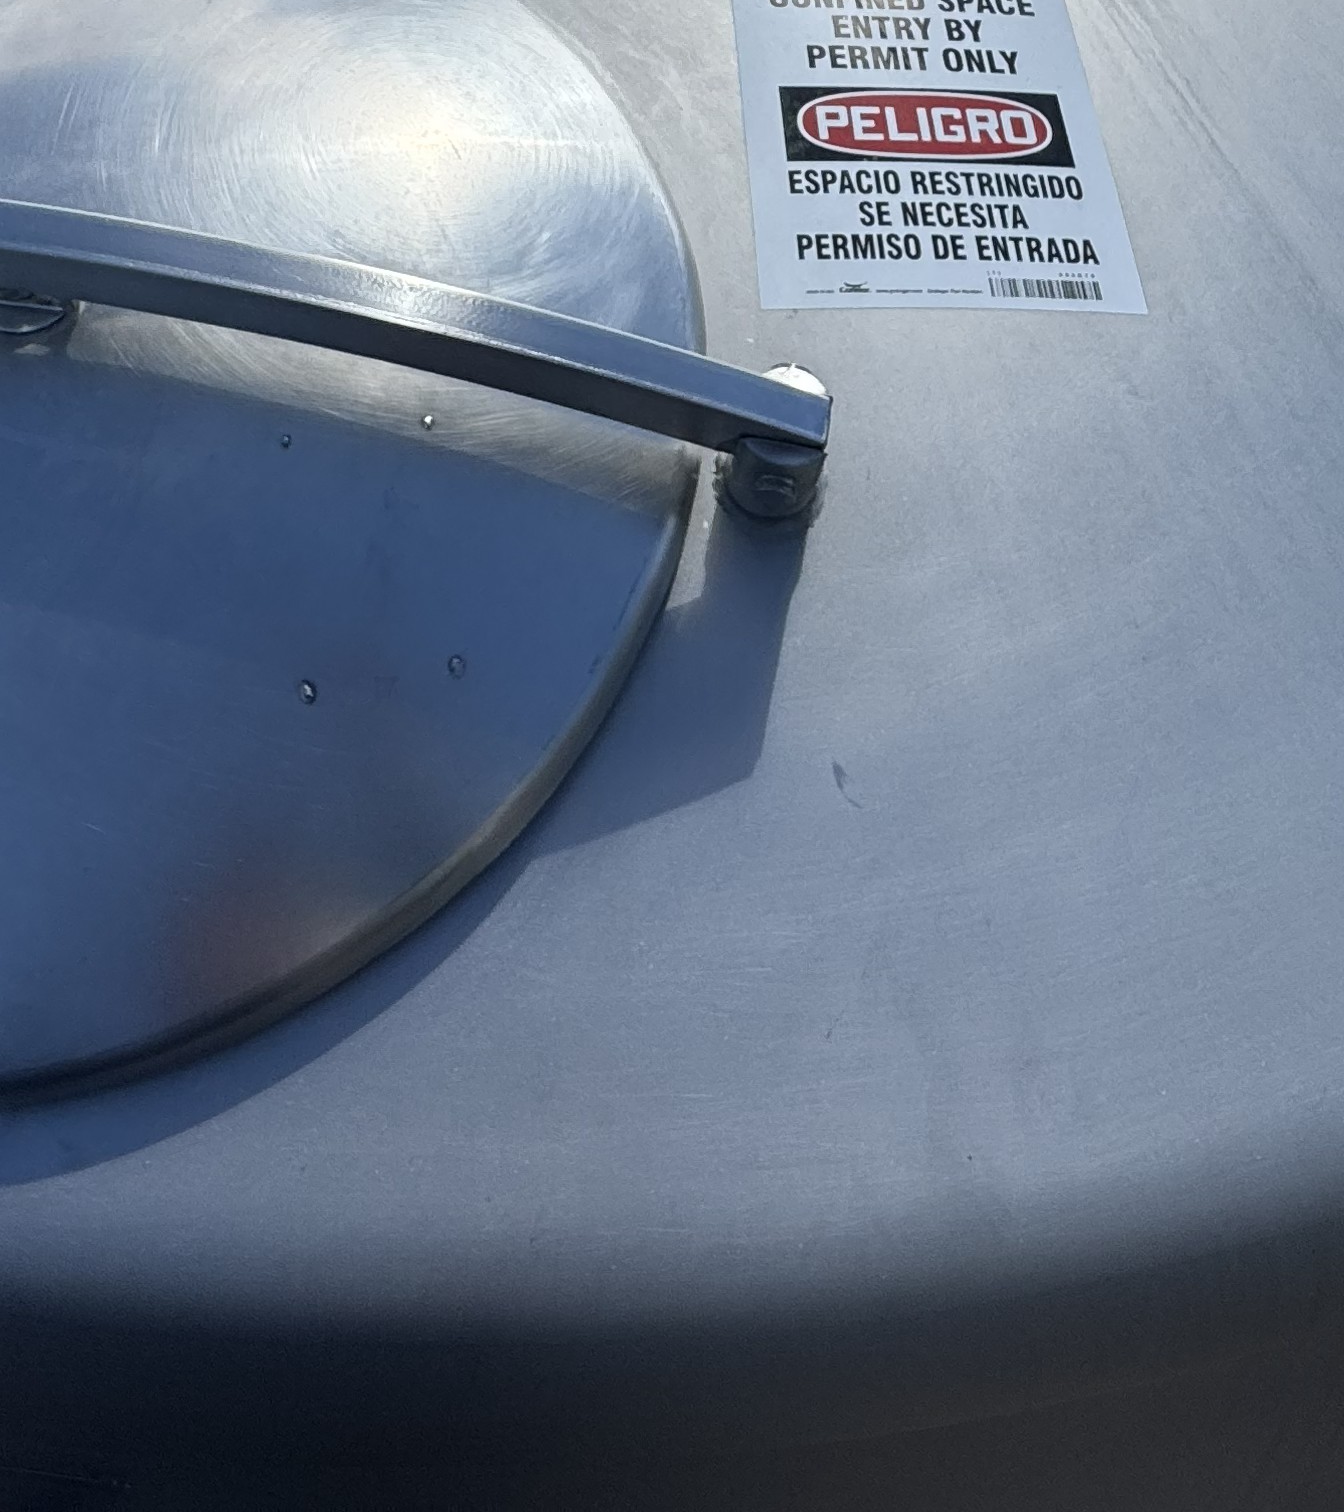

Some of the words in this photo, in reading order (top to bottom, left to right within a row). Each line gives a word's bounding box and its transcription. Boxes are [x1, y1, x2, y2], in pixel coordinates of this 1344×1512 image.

[832, 14, 931, 41] ENTRY
[943, 18, 982, 43] BY
[806, 44, 929, 71] PERMIT
[942, 47, 1018, 75] ONLY
[815, 105, 1038, 146] PELIGRO
[787, 169, 902, 195] ESPACIO
[909, 170, 1084, 201] RESTRINGIDO
[859, 201, 893, 227] SE
[901, 201, 1030, 230] NECESITA
[796, 233, 923, 261] PERMISO
[932, 234, 968, 261] DE
[975, 235, 1101, 266] ENTRADA
